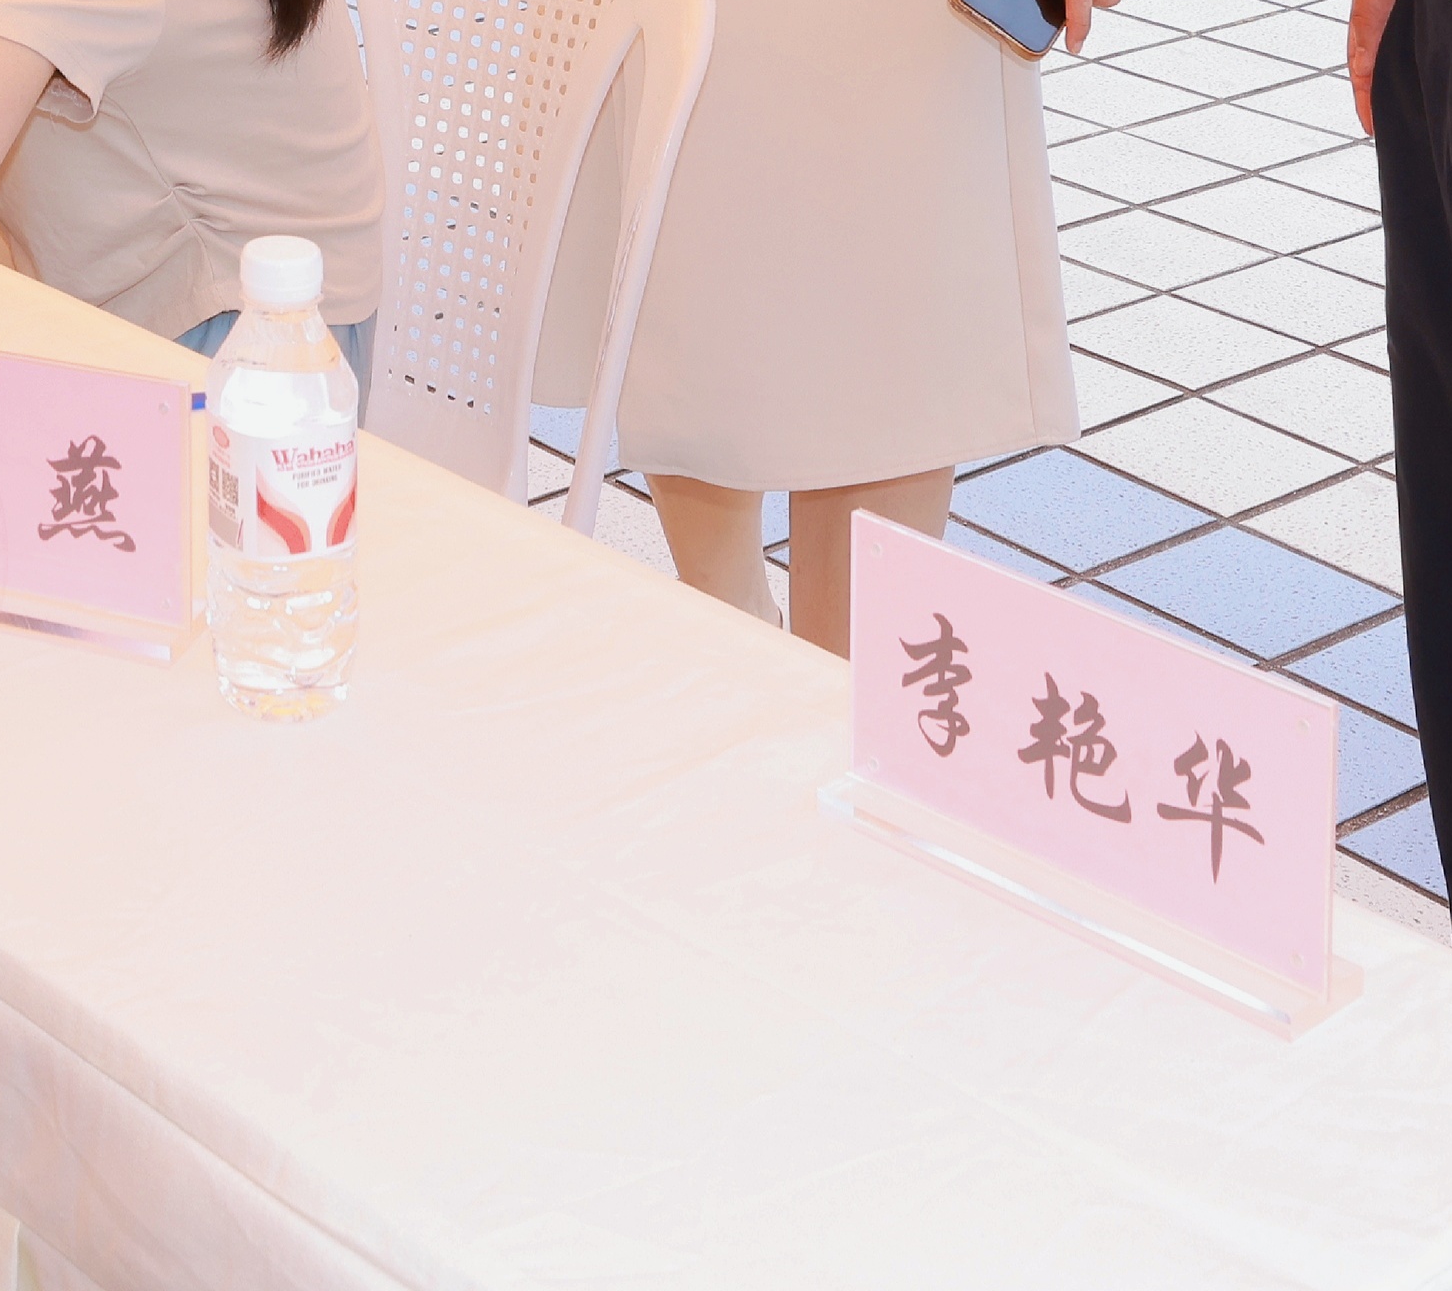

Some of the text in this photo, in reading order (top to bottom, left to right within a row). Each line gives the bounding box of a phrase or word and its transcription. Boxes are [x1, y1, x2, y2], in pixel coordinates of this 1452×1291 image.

[36, 434, 137, 553] 燕
[270, 438, 356, 467] Wahaha
[898, 611, 1266, 885] 李艳华
